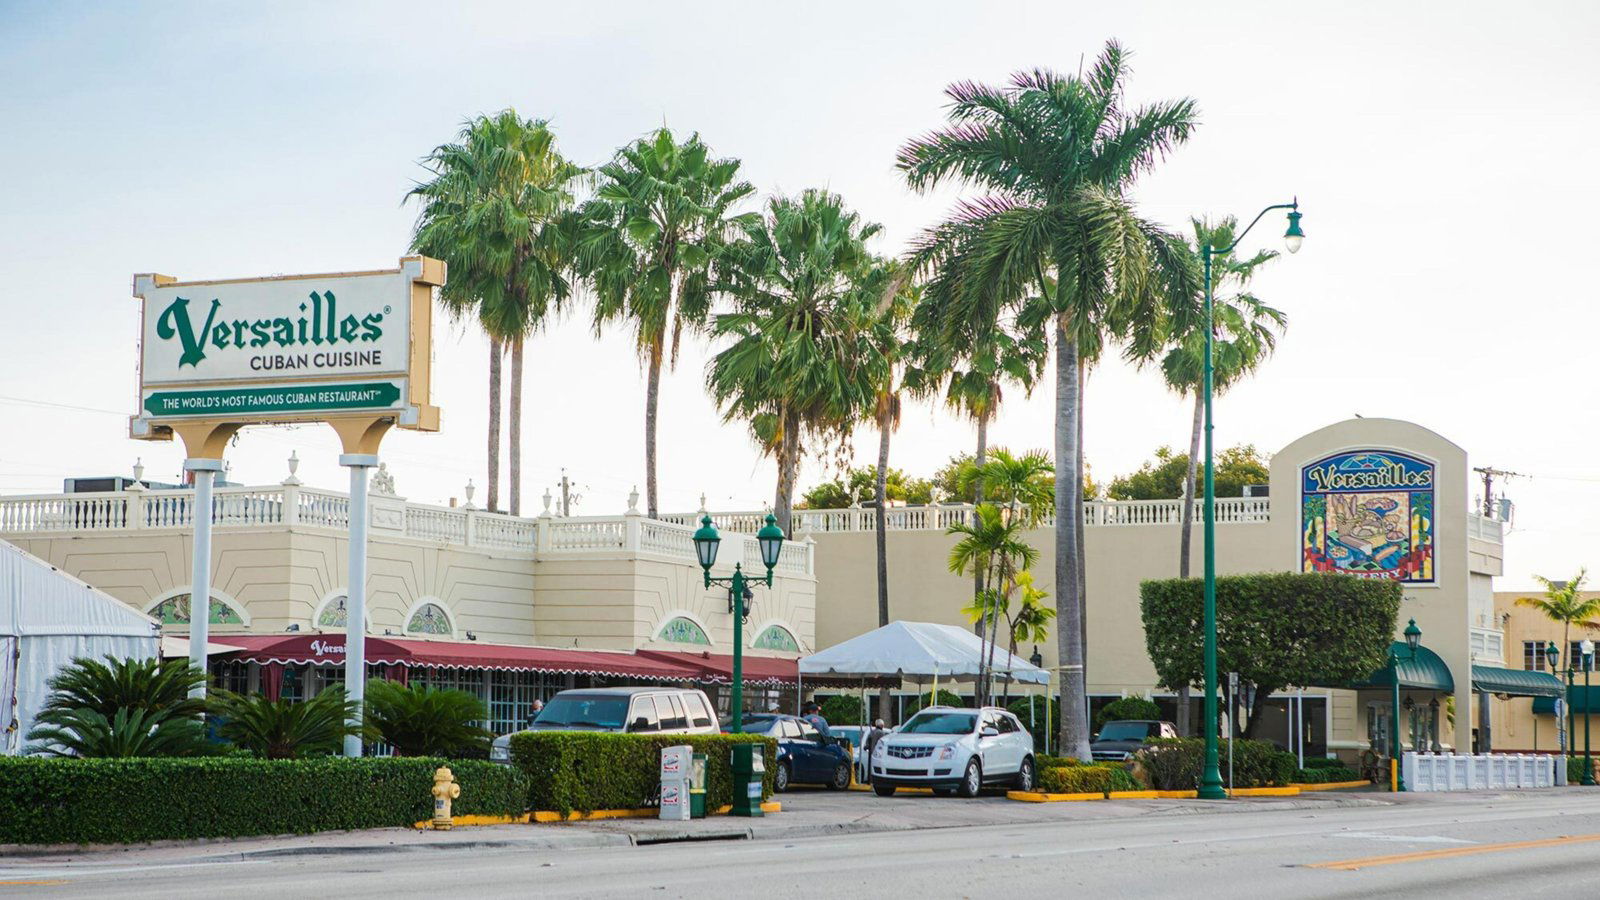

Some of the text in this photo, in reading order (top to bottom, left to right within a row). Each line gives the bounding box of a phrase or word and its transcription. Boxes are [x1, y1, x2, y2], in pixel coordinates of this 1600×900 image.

[157, 290, 383, 369] Versailles
[250, 350, 382, 371] CUBAN CUISINE
[163, 390, 376, 409] THE WORLD'S MOST FAMOUS CUBAN RESTAURANT
[1309, 463, 1431, 491] Versailles
